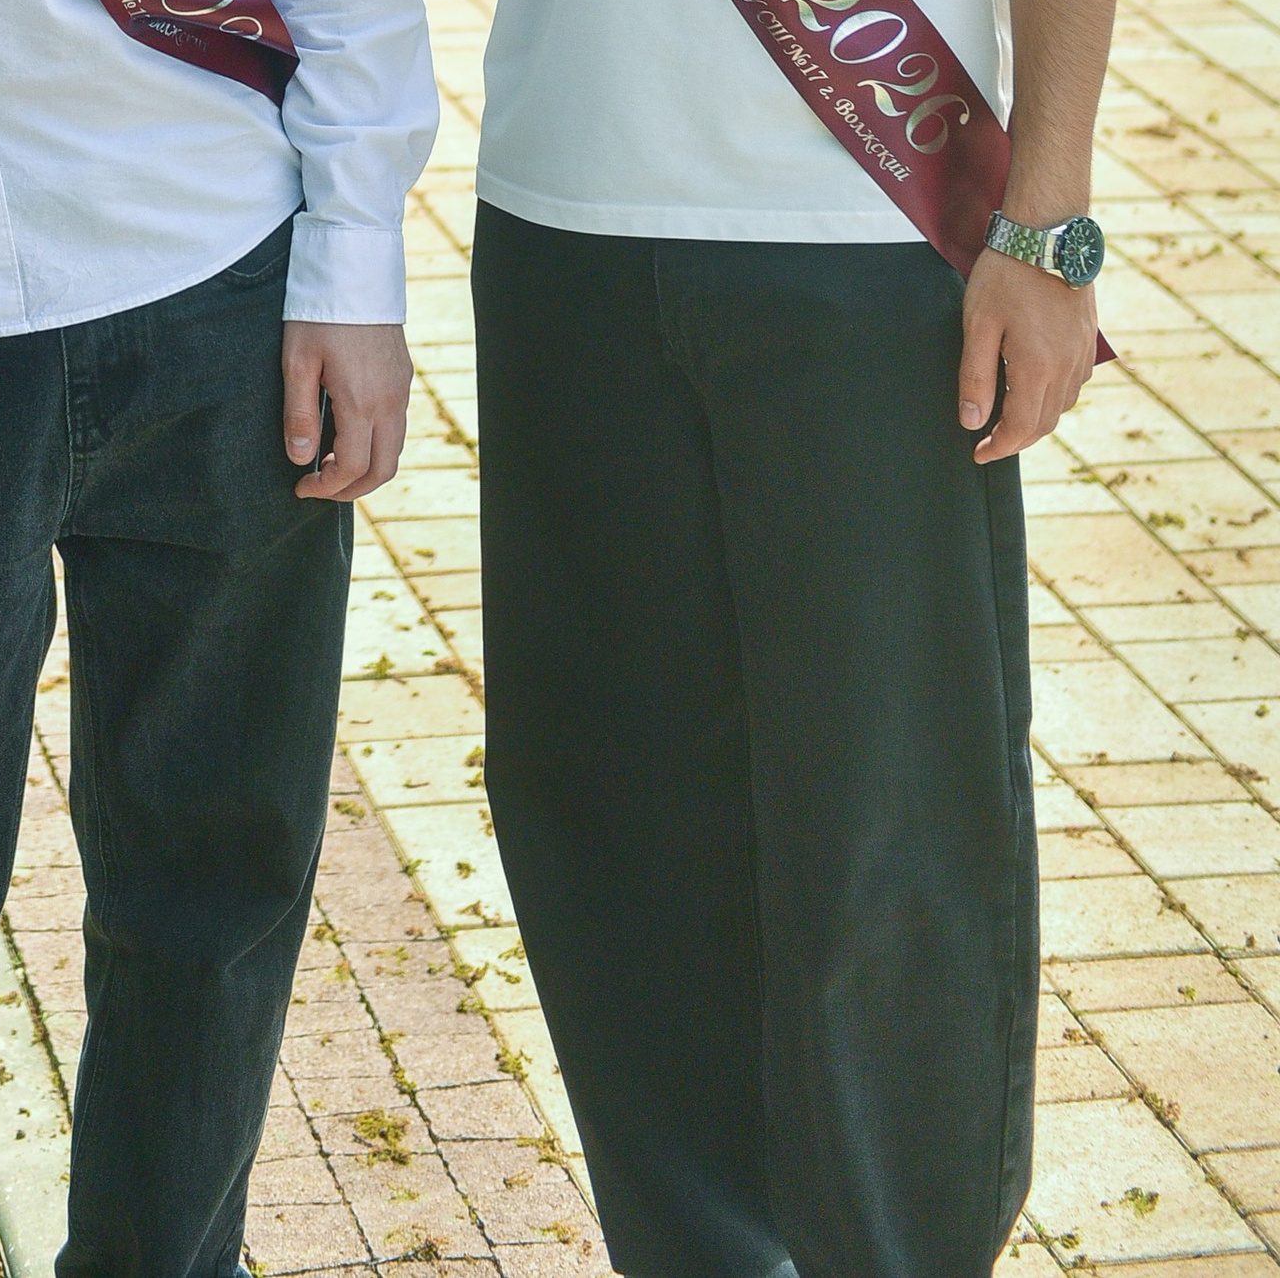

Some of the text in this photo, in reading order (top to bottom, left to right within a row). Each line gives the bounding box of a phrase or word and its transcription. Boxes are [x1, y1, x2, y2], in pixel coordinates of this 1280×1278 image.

[756, 10, 796, 44] СШ
[783, 43, 829, 82] №17
[819, 85, 833, 100] г.
[833, 98, 913, 182] Волжский
